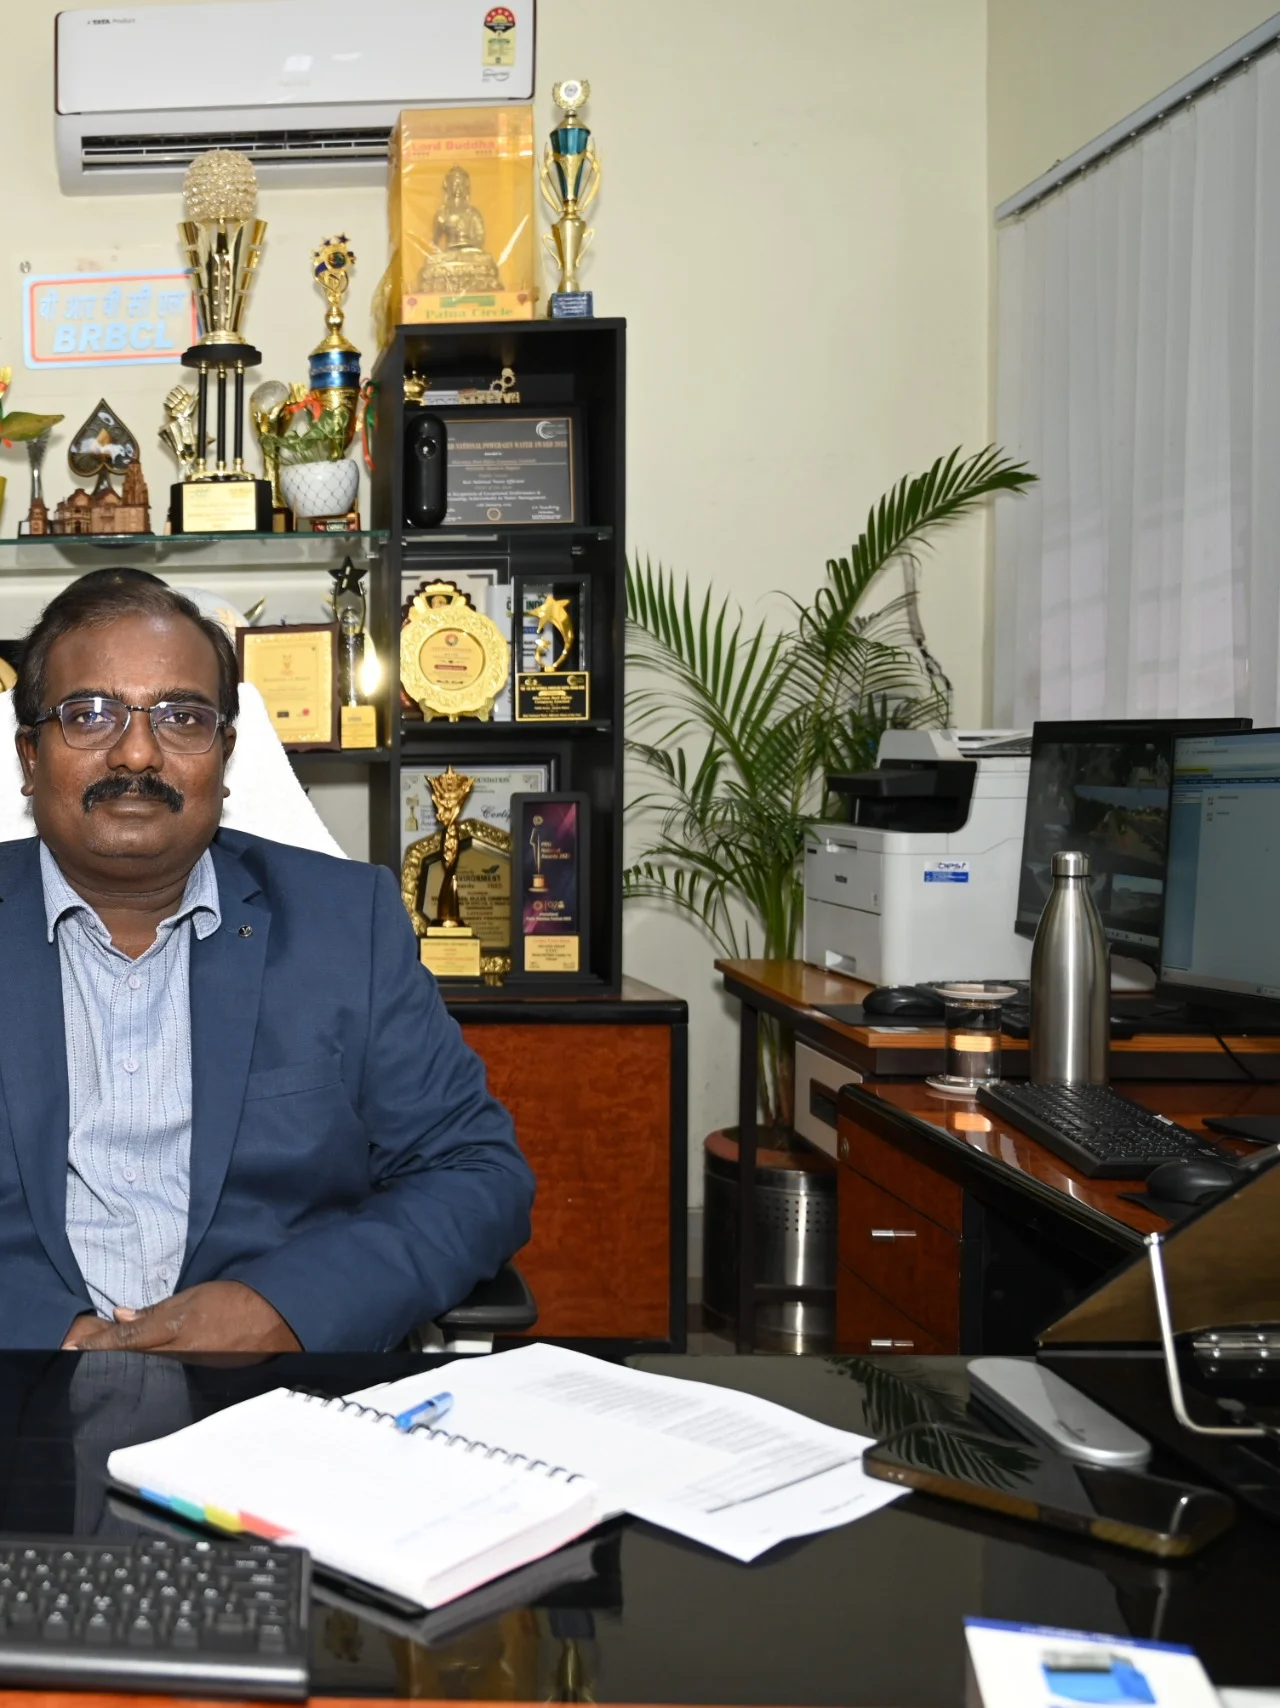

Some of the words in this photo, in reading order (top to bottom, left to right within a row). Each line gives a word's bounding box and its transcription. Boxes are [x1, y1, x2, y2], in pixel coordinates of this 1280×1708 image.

[412, 142, 441, 152] Lord
[446, 140, 495, 150] Buddha
[470, 307, 513, 318] Circle
[53, 320, 174, 354] BRBCL
